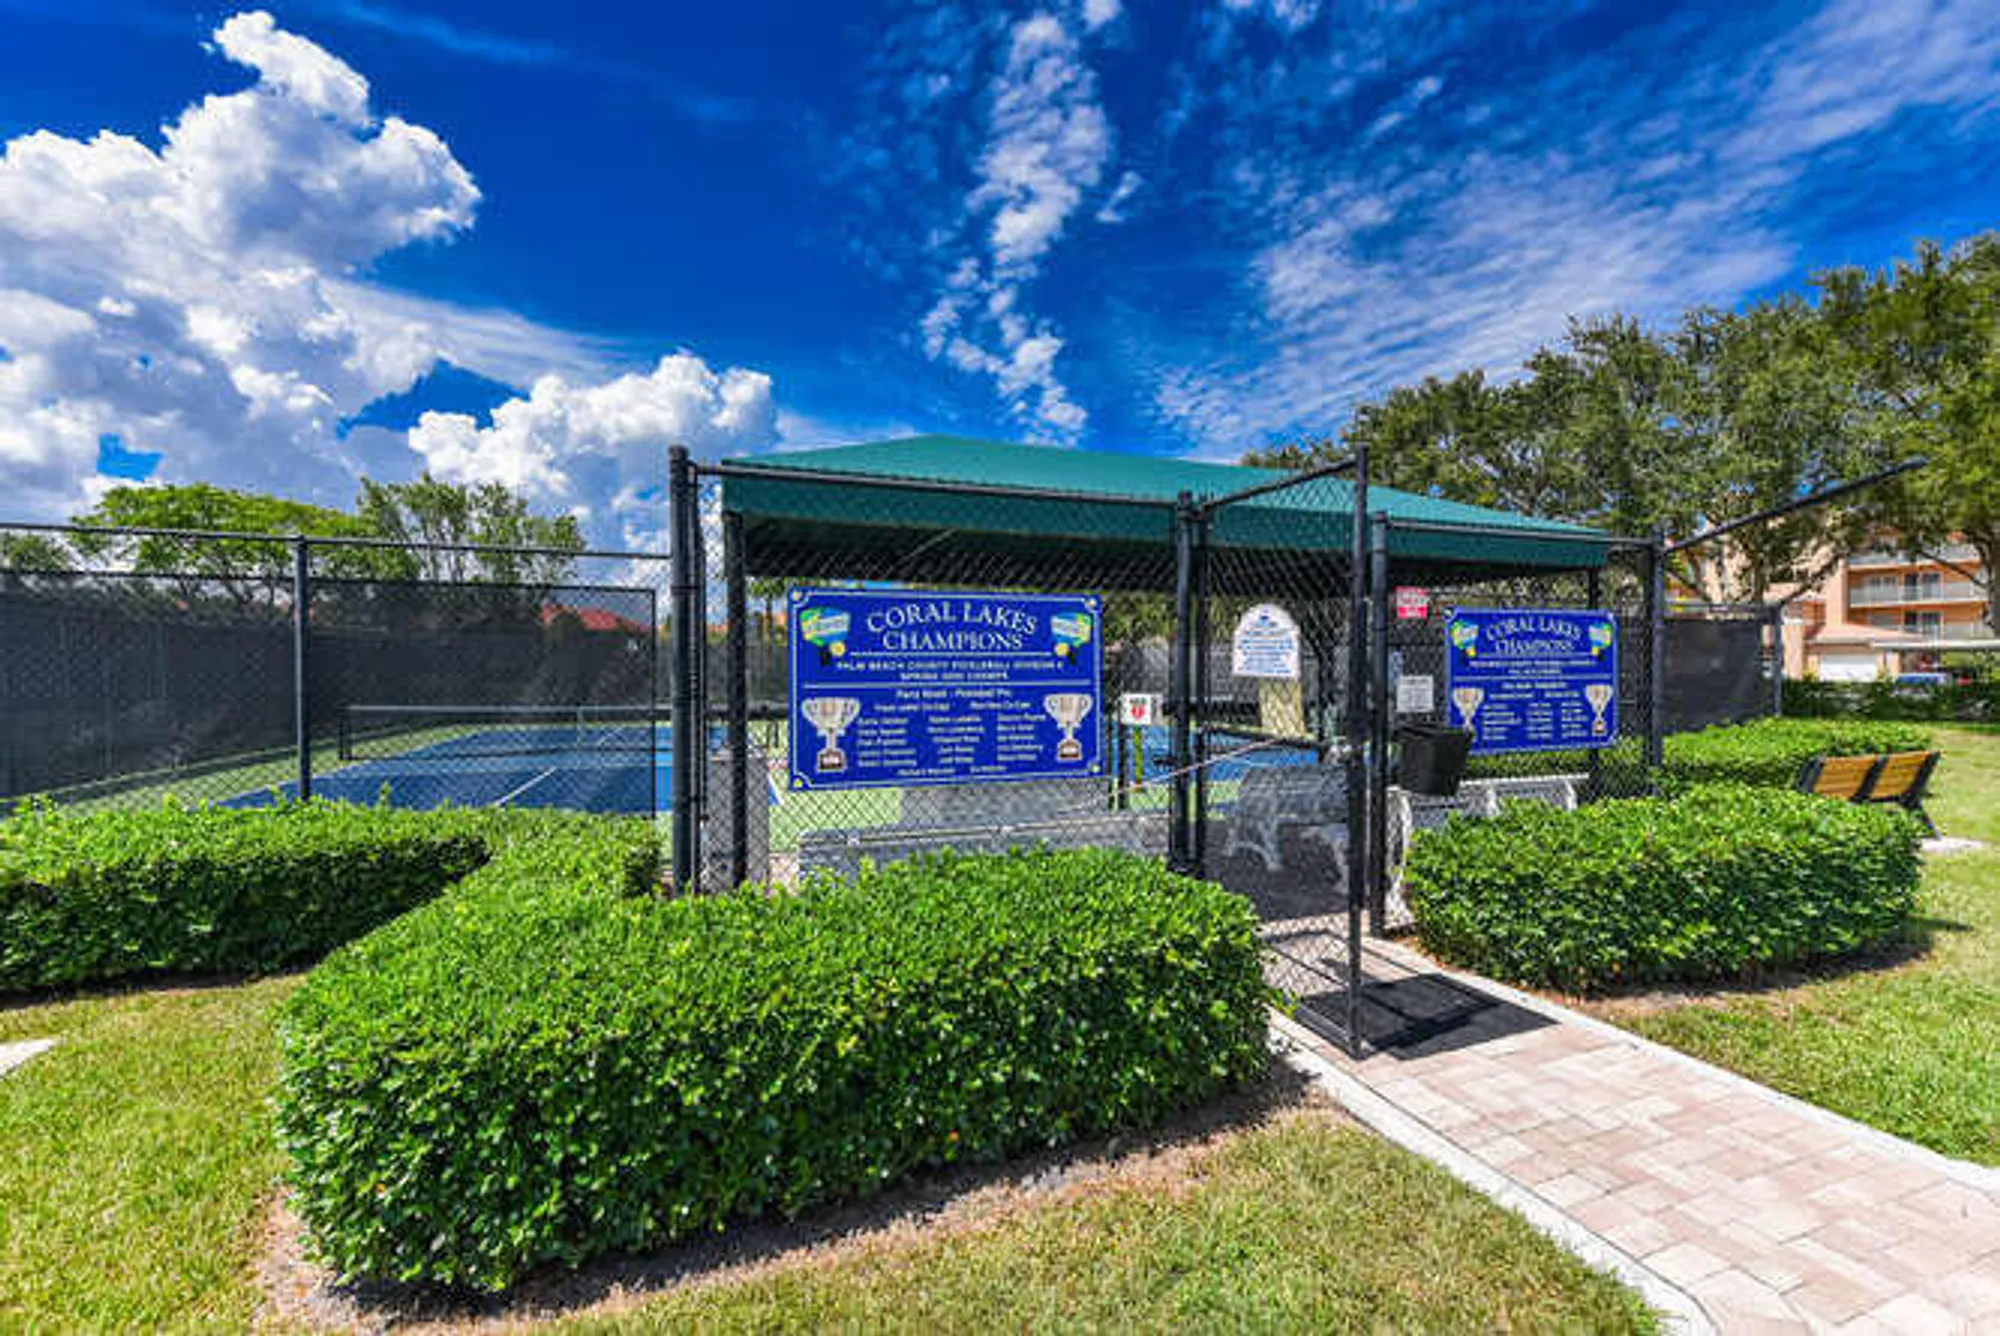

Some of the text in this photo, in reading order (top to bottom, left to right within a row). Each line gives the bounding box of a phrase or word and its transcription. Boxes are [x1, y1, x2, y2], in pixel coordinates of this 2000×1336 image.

[866, 601, 957, 632] CORAL
[963, 601, 1037, 635] LAKES
[1486, 617, 1535, 641] CORAL
[1540, 617, 1581, 641] LAKES
[883, 631, 1023, 650] CHAMPIONS
[1495, 639, 1576, 654] CHAMPIONS
